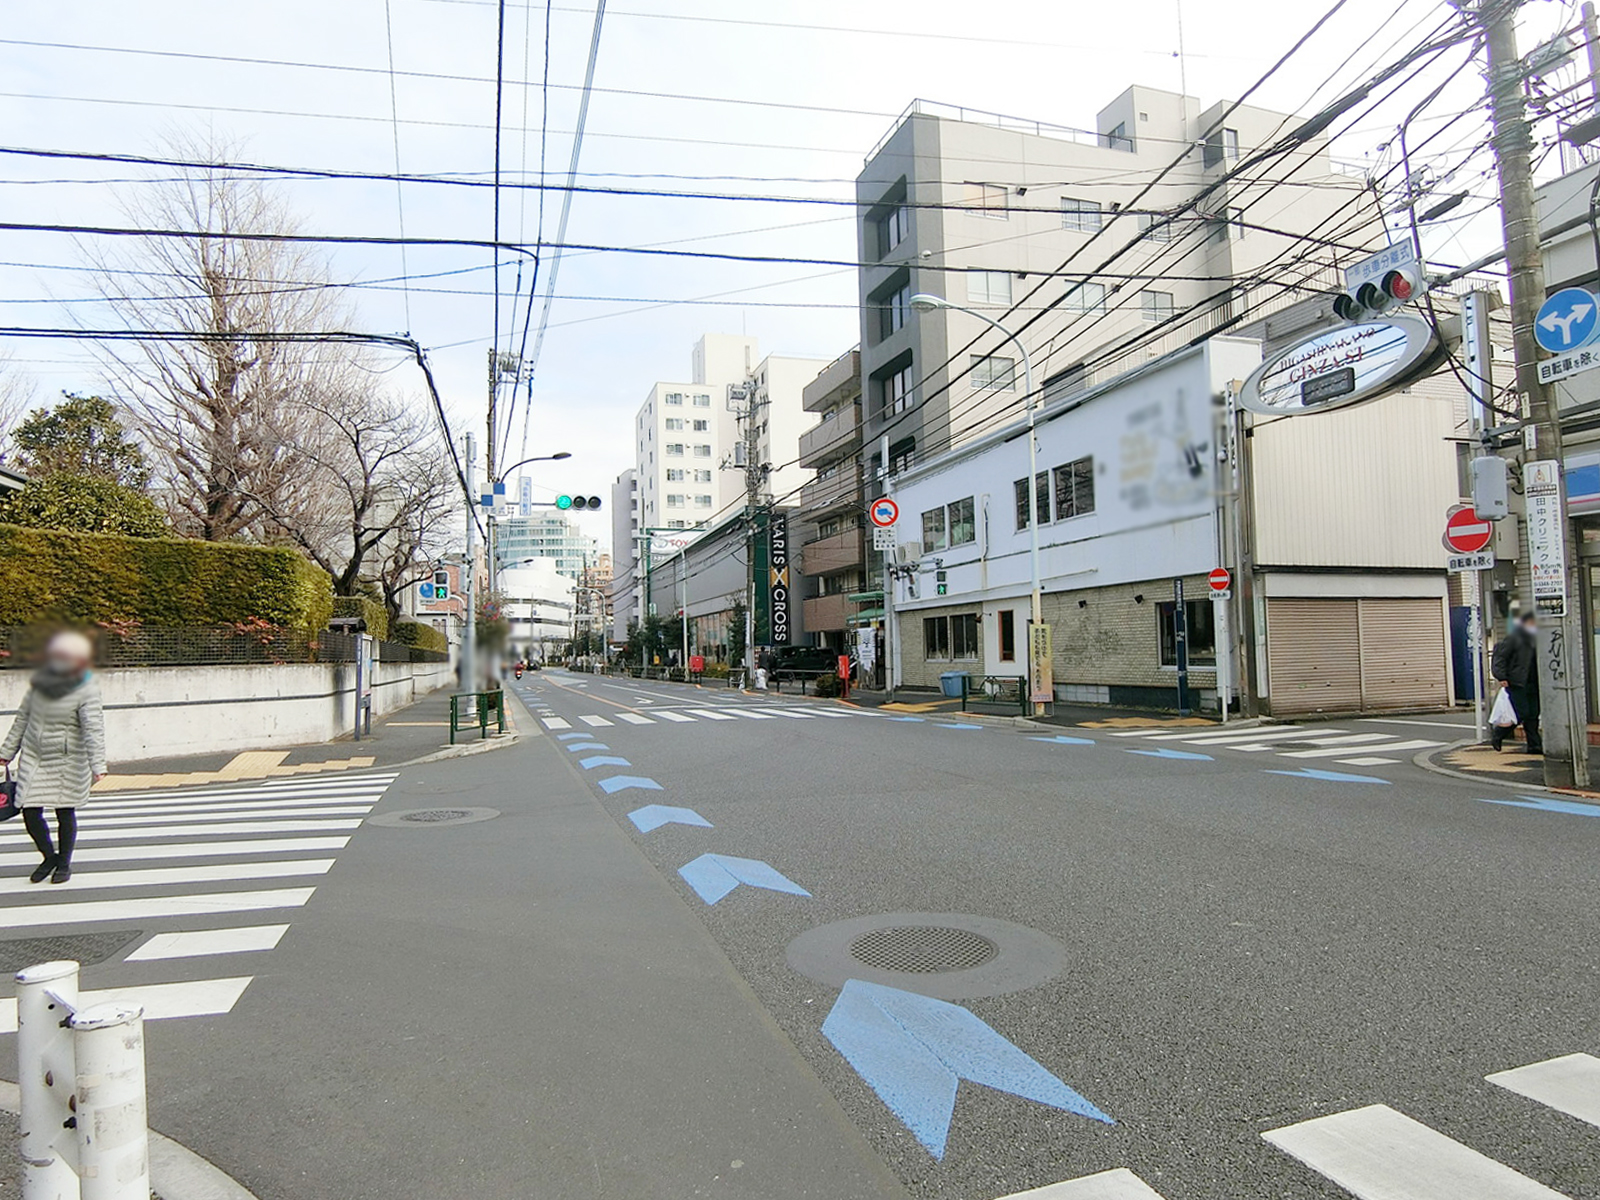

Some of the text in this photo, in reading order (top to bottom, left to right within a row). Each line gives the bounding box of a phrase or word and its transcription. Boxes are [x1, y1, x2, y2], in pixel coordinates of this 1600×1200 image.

[1363, 245, 1410, 278] 歩車分離式
[1541, 352, 1599, 379] 自転車を除く
[1536, 497, 1549, 562] 田中クリニック
[1449, 556, 1491, 569] 自転車を除く
[773, 588, 787, 641] CROSS
